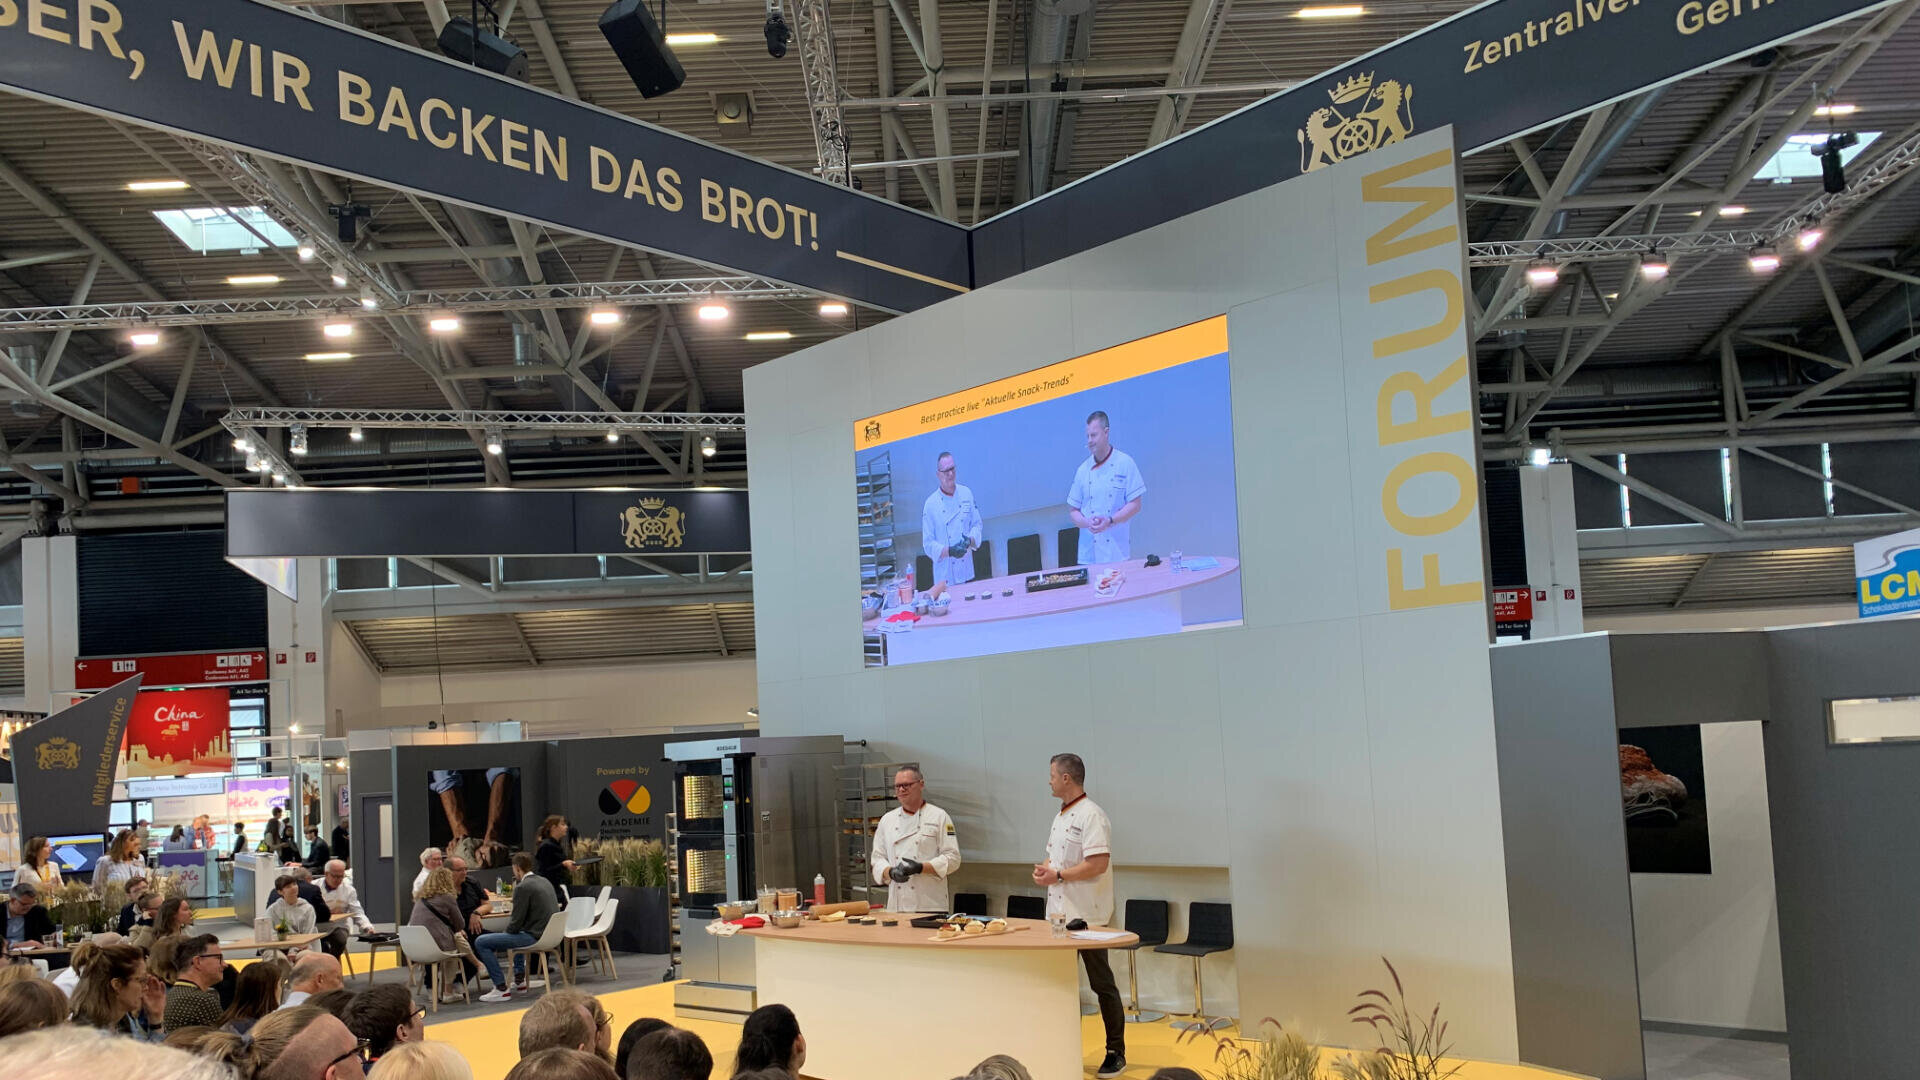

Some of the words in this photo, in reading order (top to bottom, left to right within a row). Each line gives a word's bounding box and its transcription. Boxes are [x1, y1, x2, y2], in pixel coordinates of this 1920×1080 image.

[1463, 0, 1640, 74] Zentralve
[172, 20, 314, 112] WIR
[338, 70, 568, 182] BACKEN
[590, 145, 684, 212] DAS
[700, 178, 819, 251] BROT!
[1361, 148, 1484, 611] FORUM
[920, 412, 936, 424] Best
[937, 405, 965, 421] practice
[966, 401, 980, 412] live
[154, 704, 206, 722] China
[92, 697, 127, 806] Mitgliederservice
[596, 767, 636, 776] Powered
[638, 766, 650, 776] by
[601, 817, 650, 827] AKADEMIE
